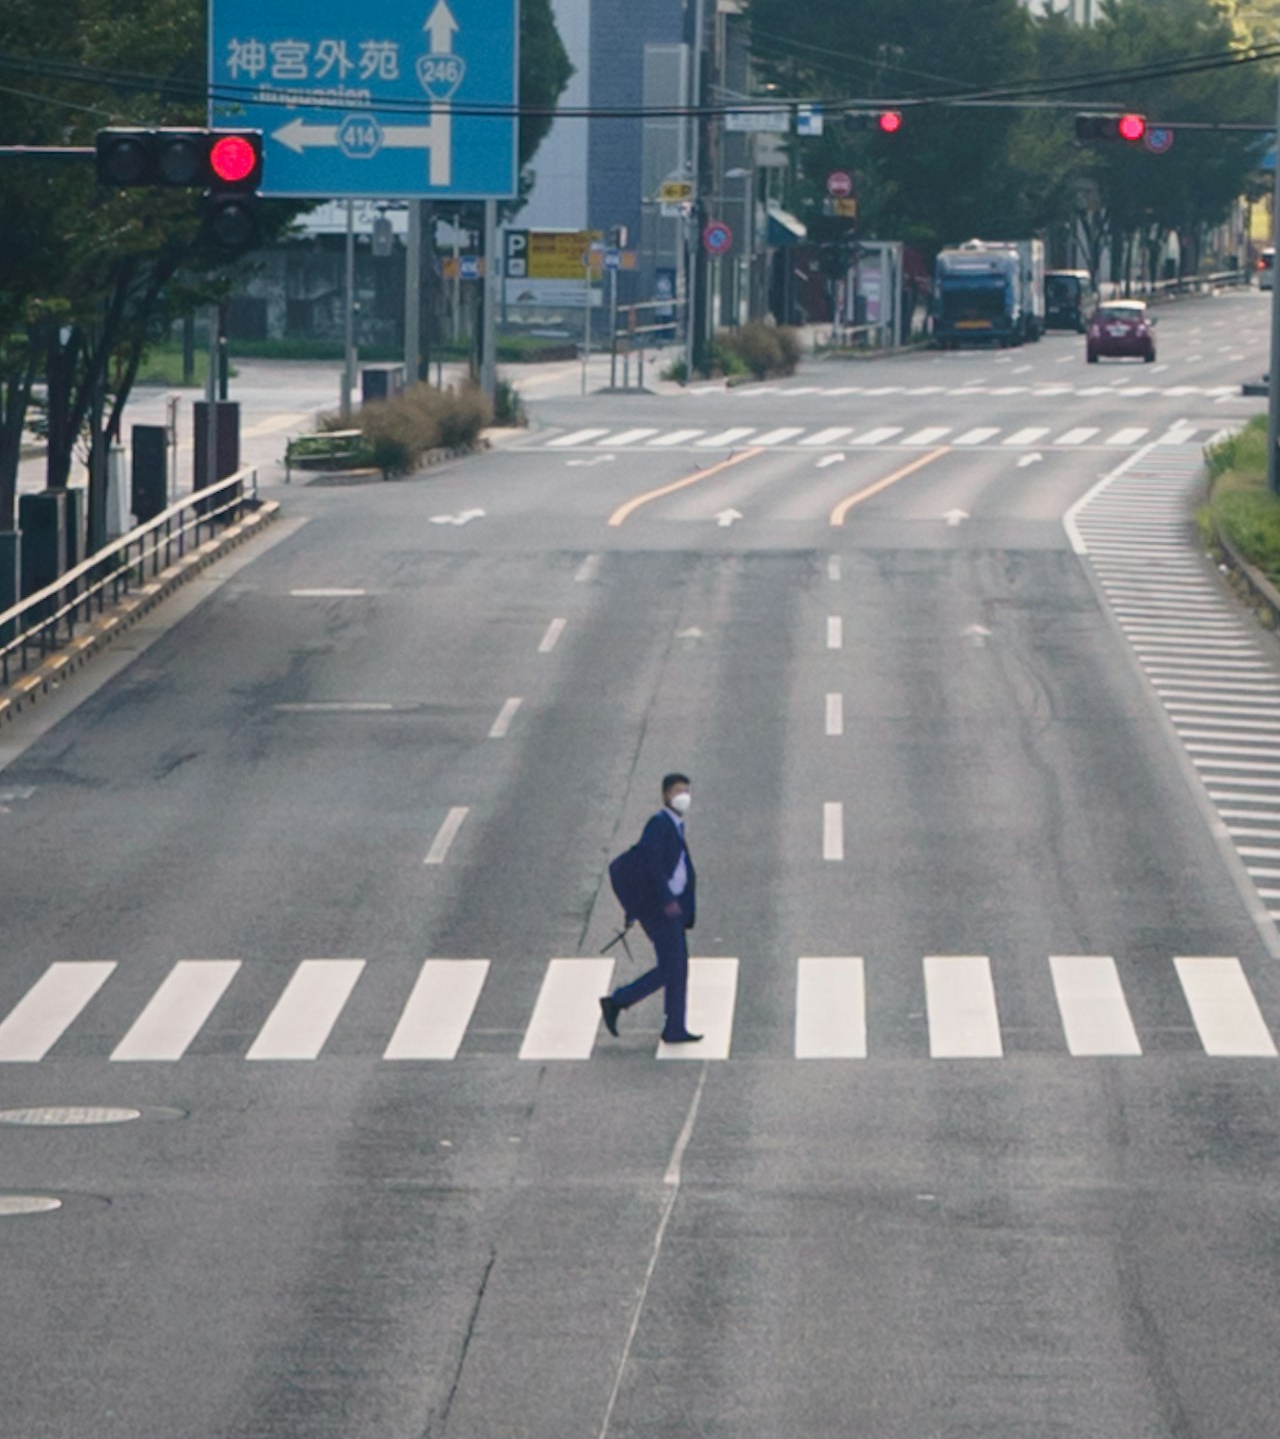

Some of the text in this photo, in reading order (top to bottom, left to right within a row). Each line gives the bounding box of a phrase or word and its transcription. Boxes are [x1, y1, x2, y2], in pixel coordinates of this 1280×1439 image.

[227, 38, 400, 80] 神宮外苑
[422, 62, 458, 82] 246
[344, 126, 375, 145] 414
[509, 235, 526, 255] P
